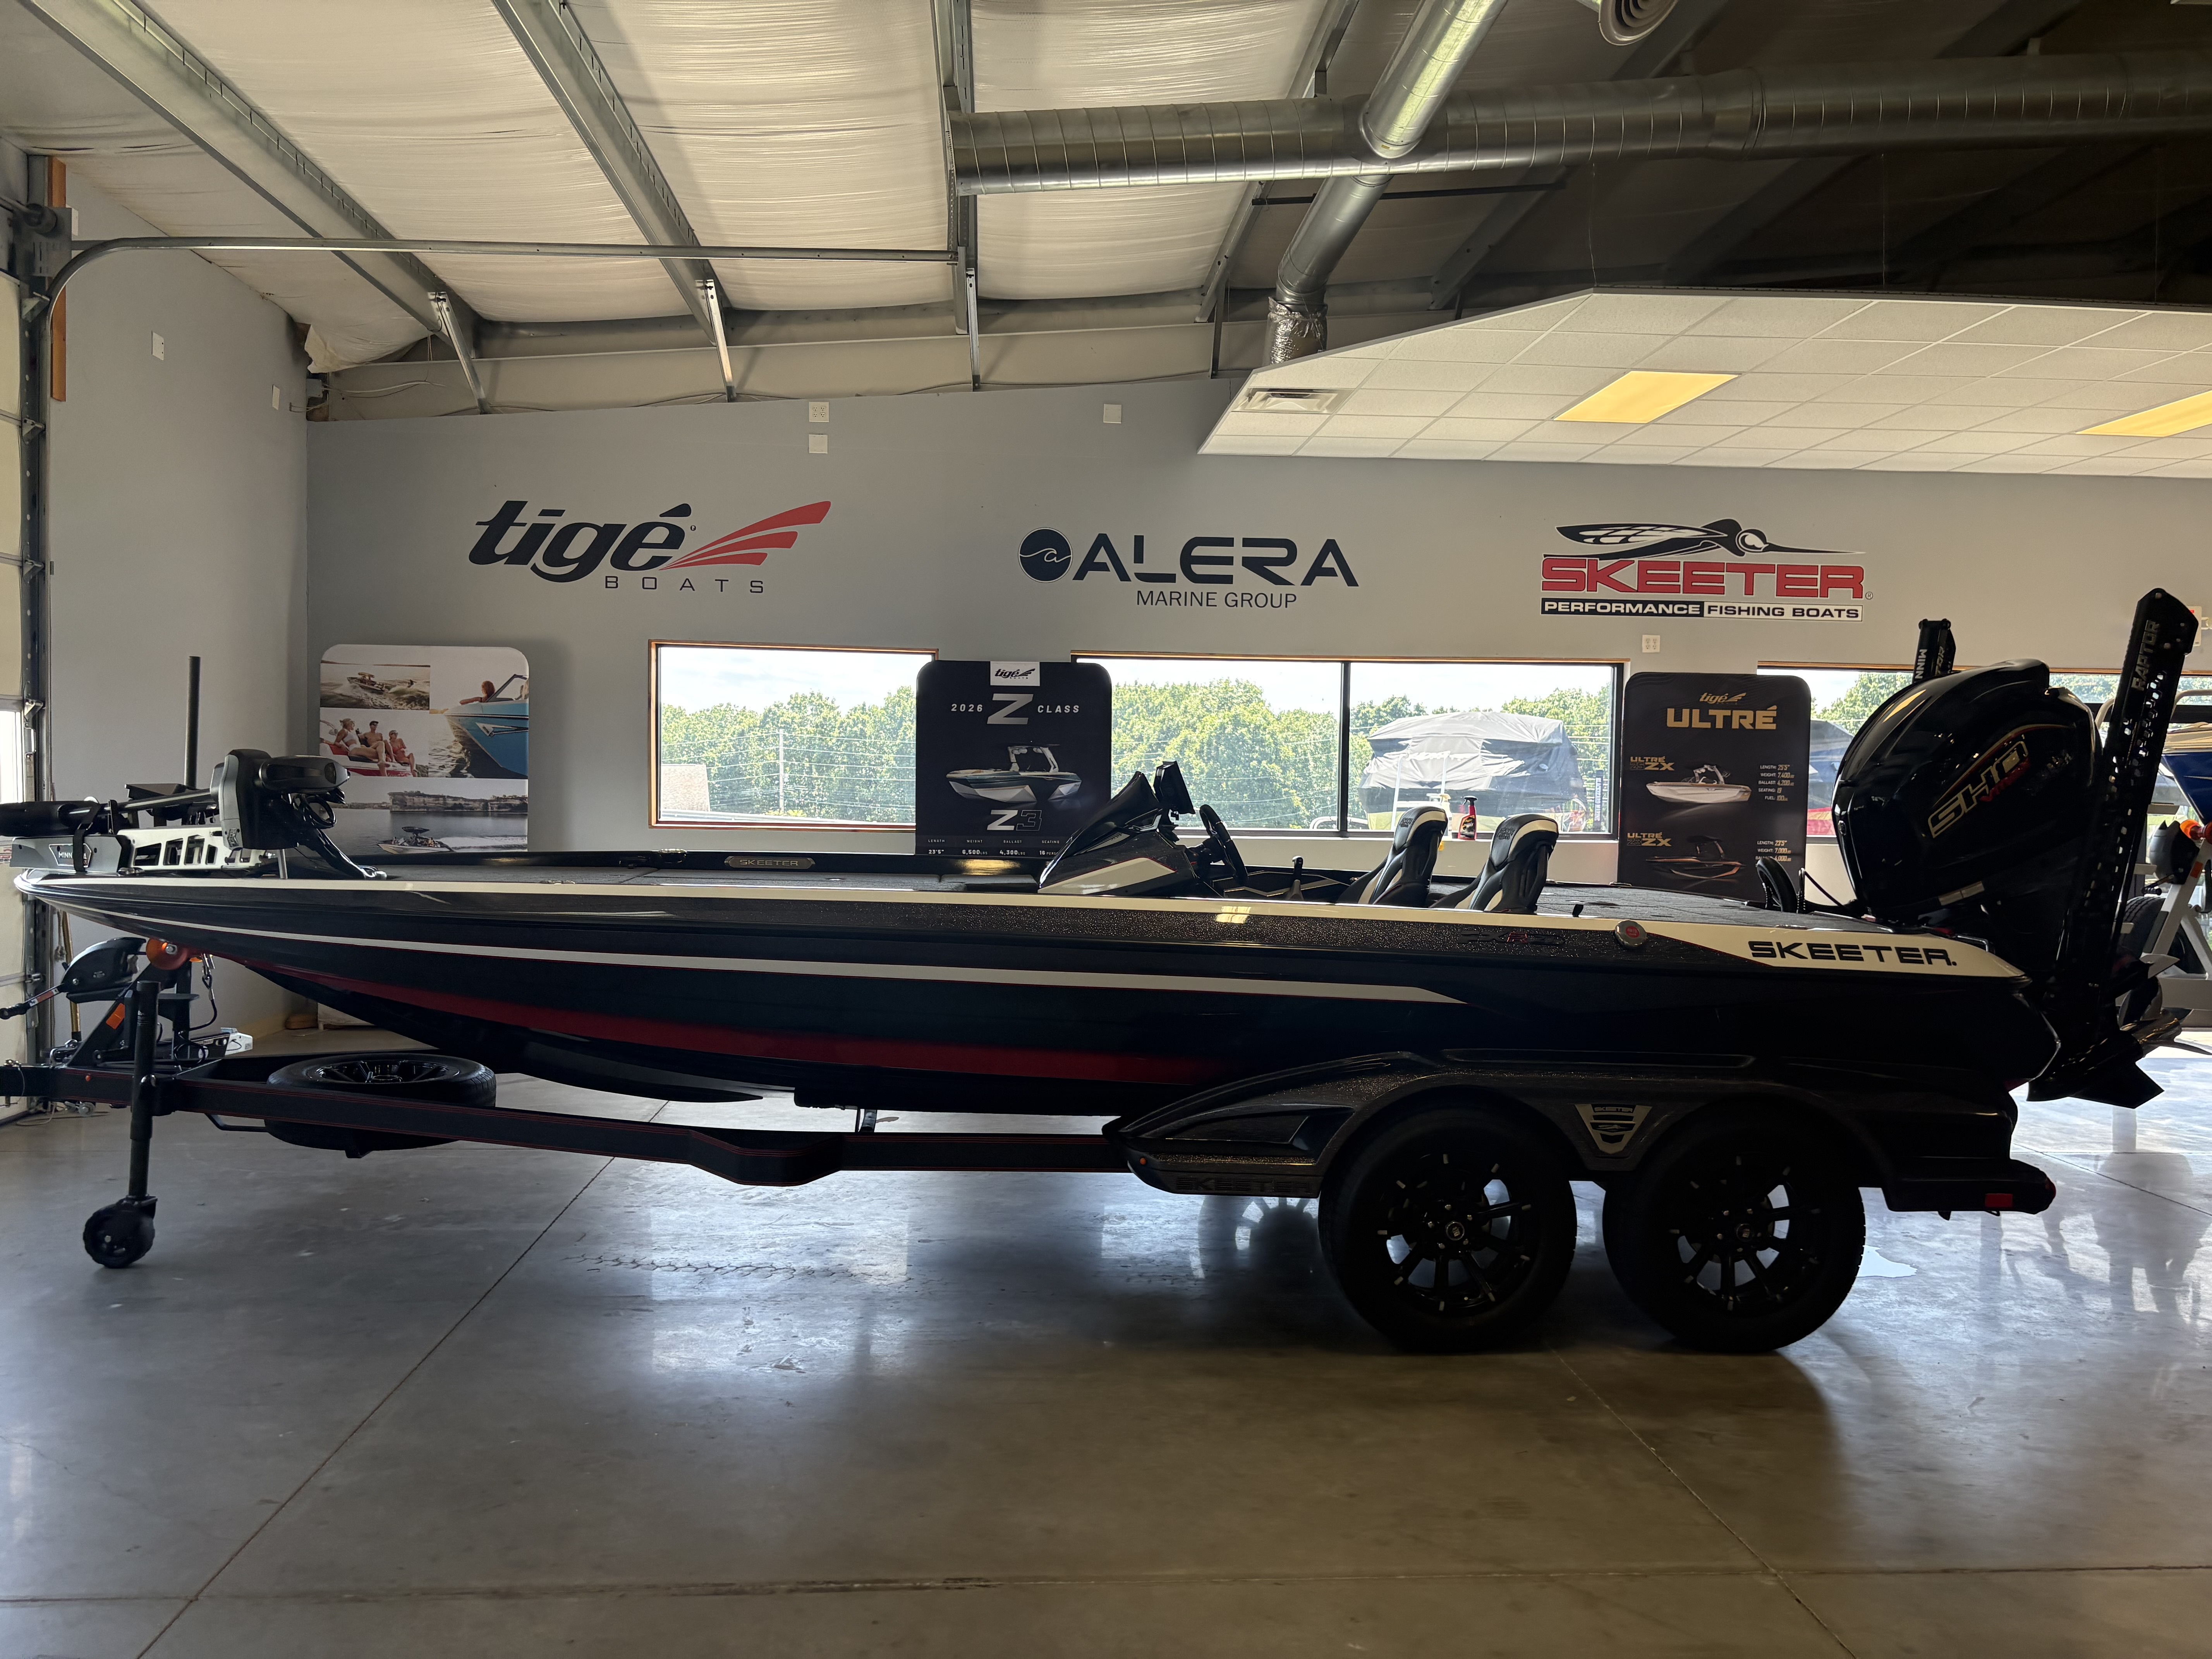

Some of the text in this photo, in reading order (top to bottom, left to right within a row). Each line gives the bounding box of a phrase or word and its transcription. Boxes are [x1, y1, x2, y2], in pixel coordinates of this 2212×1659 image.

[469, 500, 692, 583] tigé
[1072, 533, 1359, 587] ALERA
[605, 575, 764, 594] BOATS
[1541, 558, 1864, 599] SKEETER
[1137, 590, 1297, 608] MARINE GROUP
[1544, 601, 1859, 618] PERFORMANCE FISHING BOATS
[1915, 649, 1927, 679] MINN
[1935, 646, 1945, 676] TOR
[2131, 620, 2160, 691] RAPTOR
[995, 669, 1020, 678] tigé
[951, 693, 1080, 725] 2026 Z CLASS
[1699, 692, 1729, 704] tigé
[1666, 705, 1777, 730] ULTRÉ
[1927, 740, 2029, 839] SHO
[987, 809, 1042, 831] Z3
